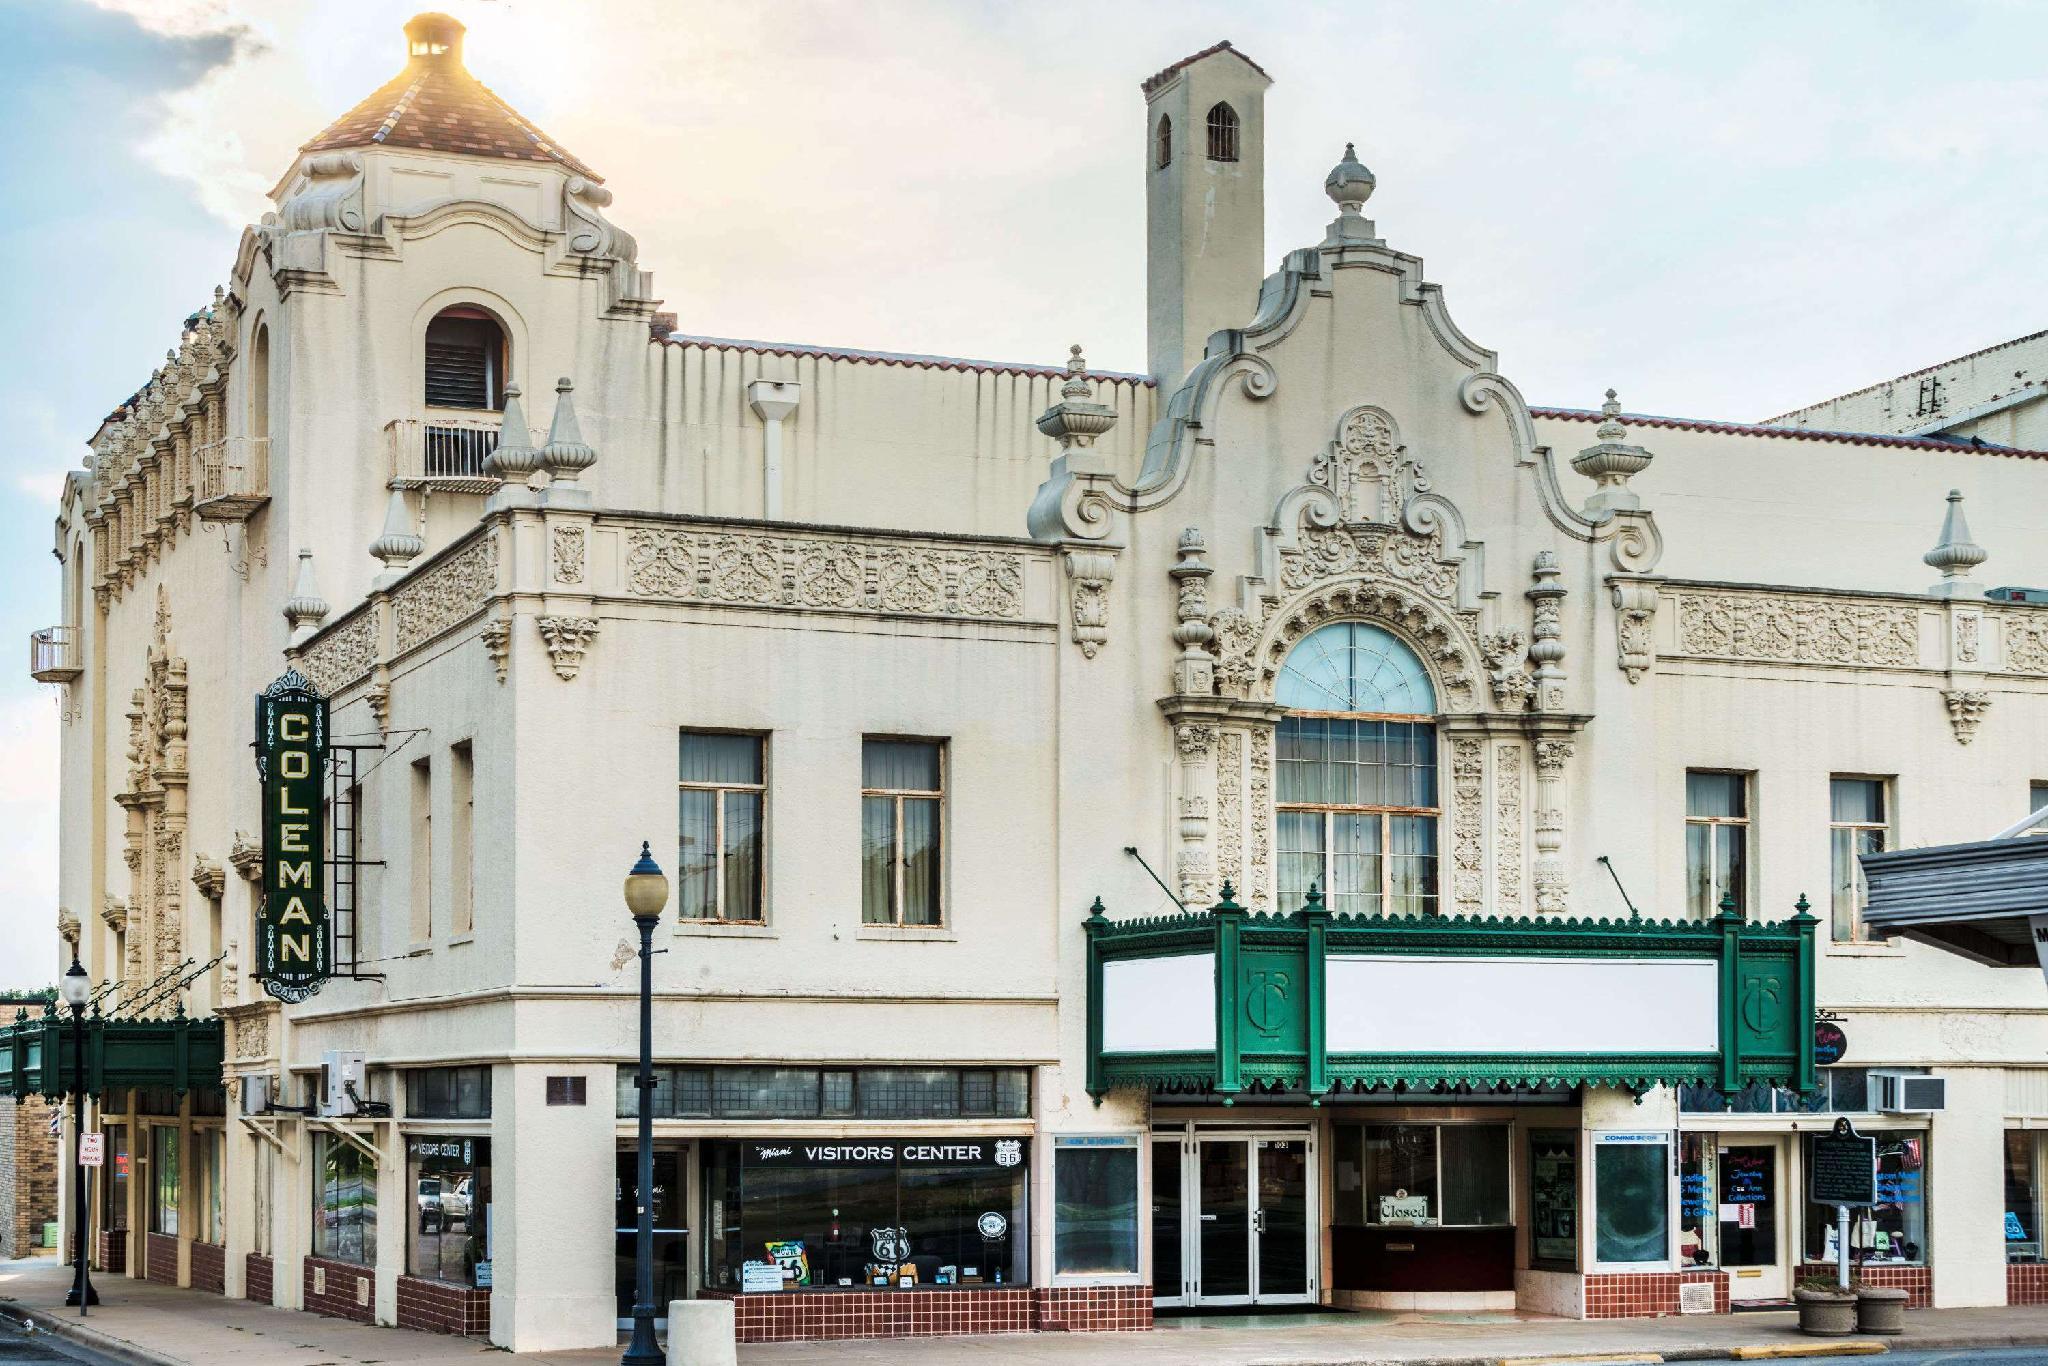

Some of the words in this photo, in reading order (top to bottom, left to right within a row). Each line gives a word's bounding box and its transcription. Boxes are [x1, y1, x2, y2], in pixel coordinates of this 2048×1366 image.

[278, 713, 312, 962] COLEMAN
[440, 1143, 460, 1157] CENTER
[759, 1146, 793, 1159] Miami
[804, 1146, 894, 1160] VISITORS
[903, 1145, 983, 1160] CENTER
[1000, 1153, 1016, 1162] 66
[1728, 1193, 1766, 1202] Collections
[1381, 1205, 1425, 1218] Closed
